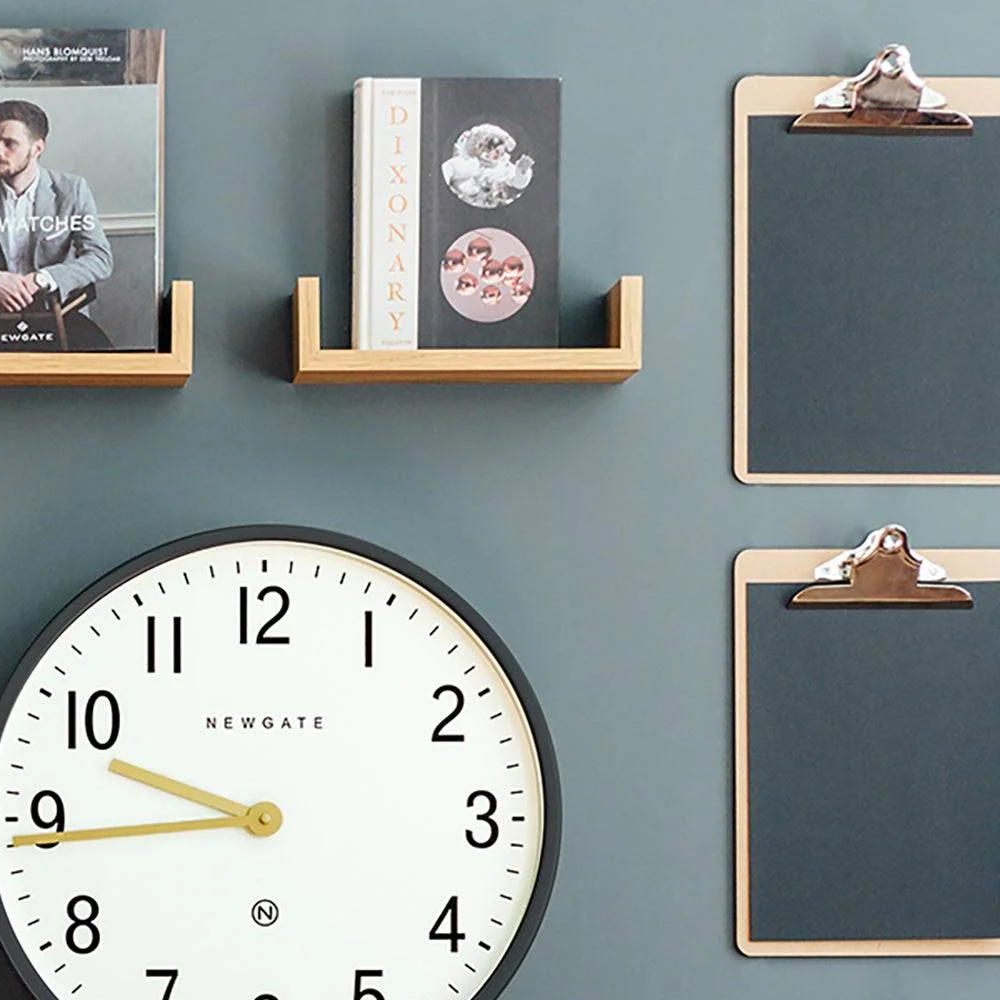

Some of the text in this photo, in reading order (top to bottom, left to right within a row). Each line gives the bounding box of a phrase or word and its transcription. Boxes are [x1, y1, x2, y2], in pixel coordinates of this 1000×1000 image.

[22, 46, 109, 56] HANS BLOMQUIST
[388, 106, 408, 331] DIXONARY
[145, 615, 182, 674] 11
[239, 585, 290, 645] 12
[364, 610, 373, 668] 1
[67, 689, 121, 750] 10
[206, 717, 324, 730] NEWGATE
[431, 684, 465, 743] 2
[30, 789, 66, 849] 9
[465, 789, 499, 849] 3
[65, 894, 101, 955] 8
[428, 895, 466, 953] 4
